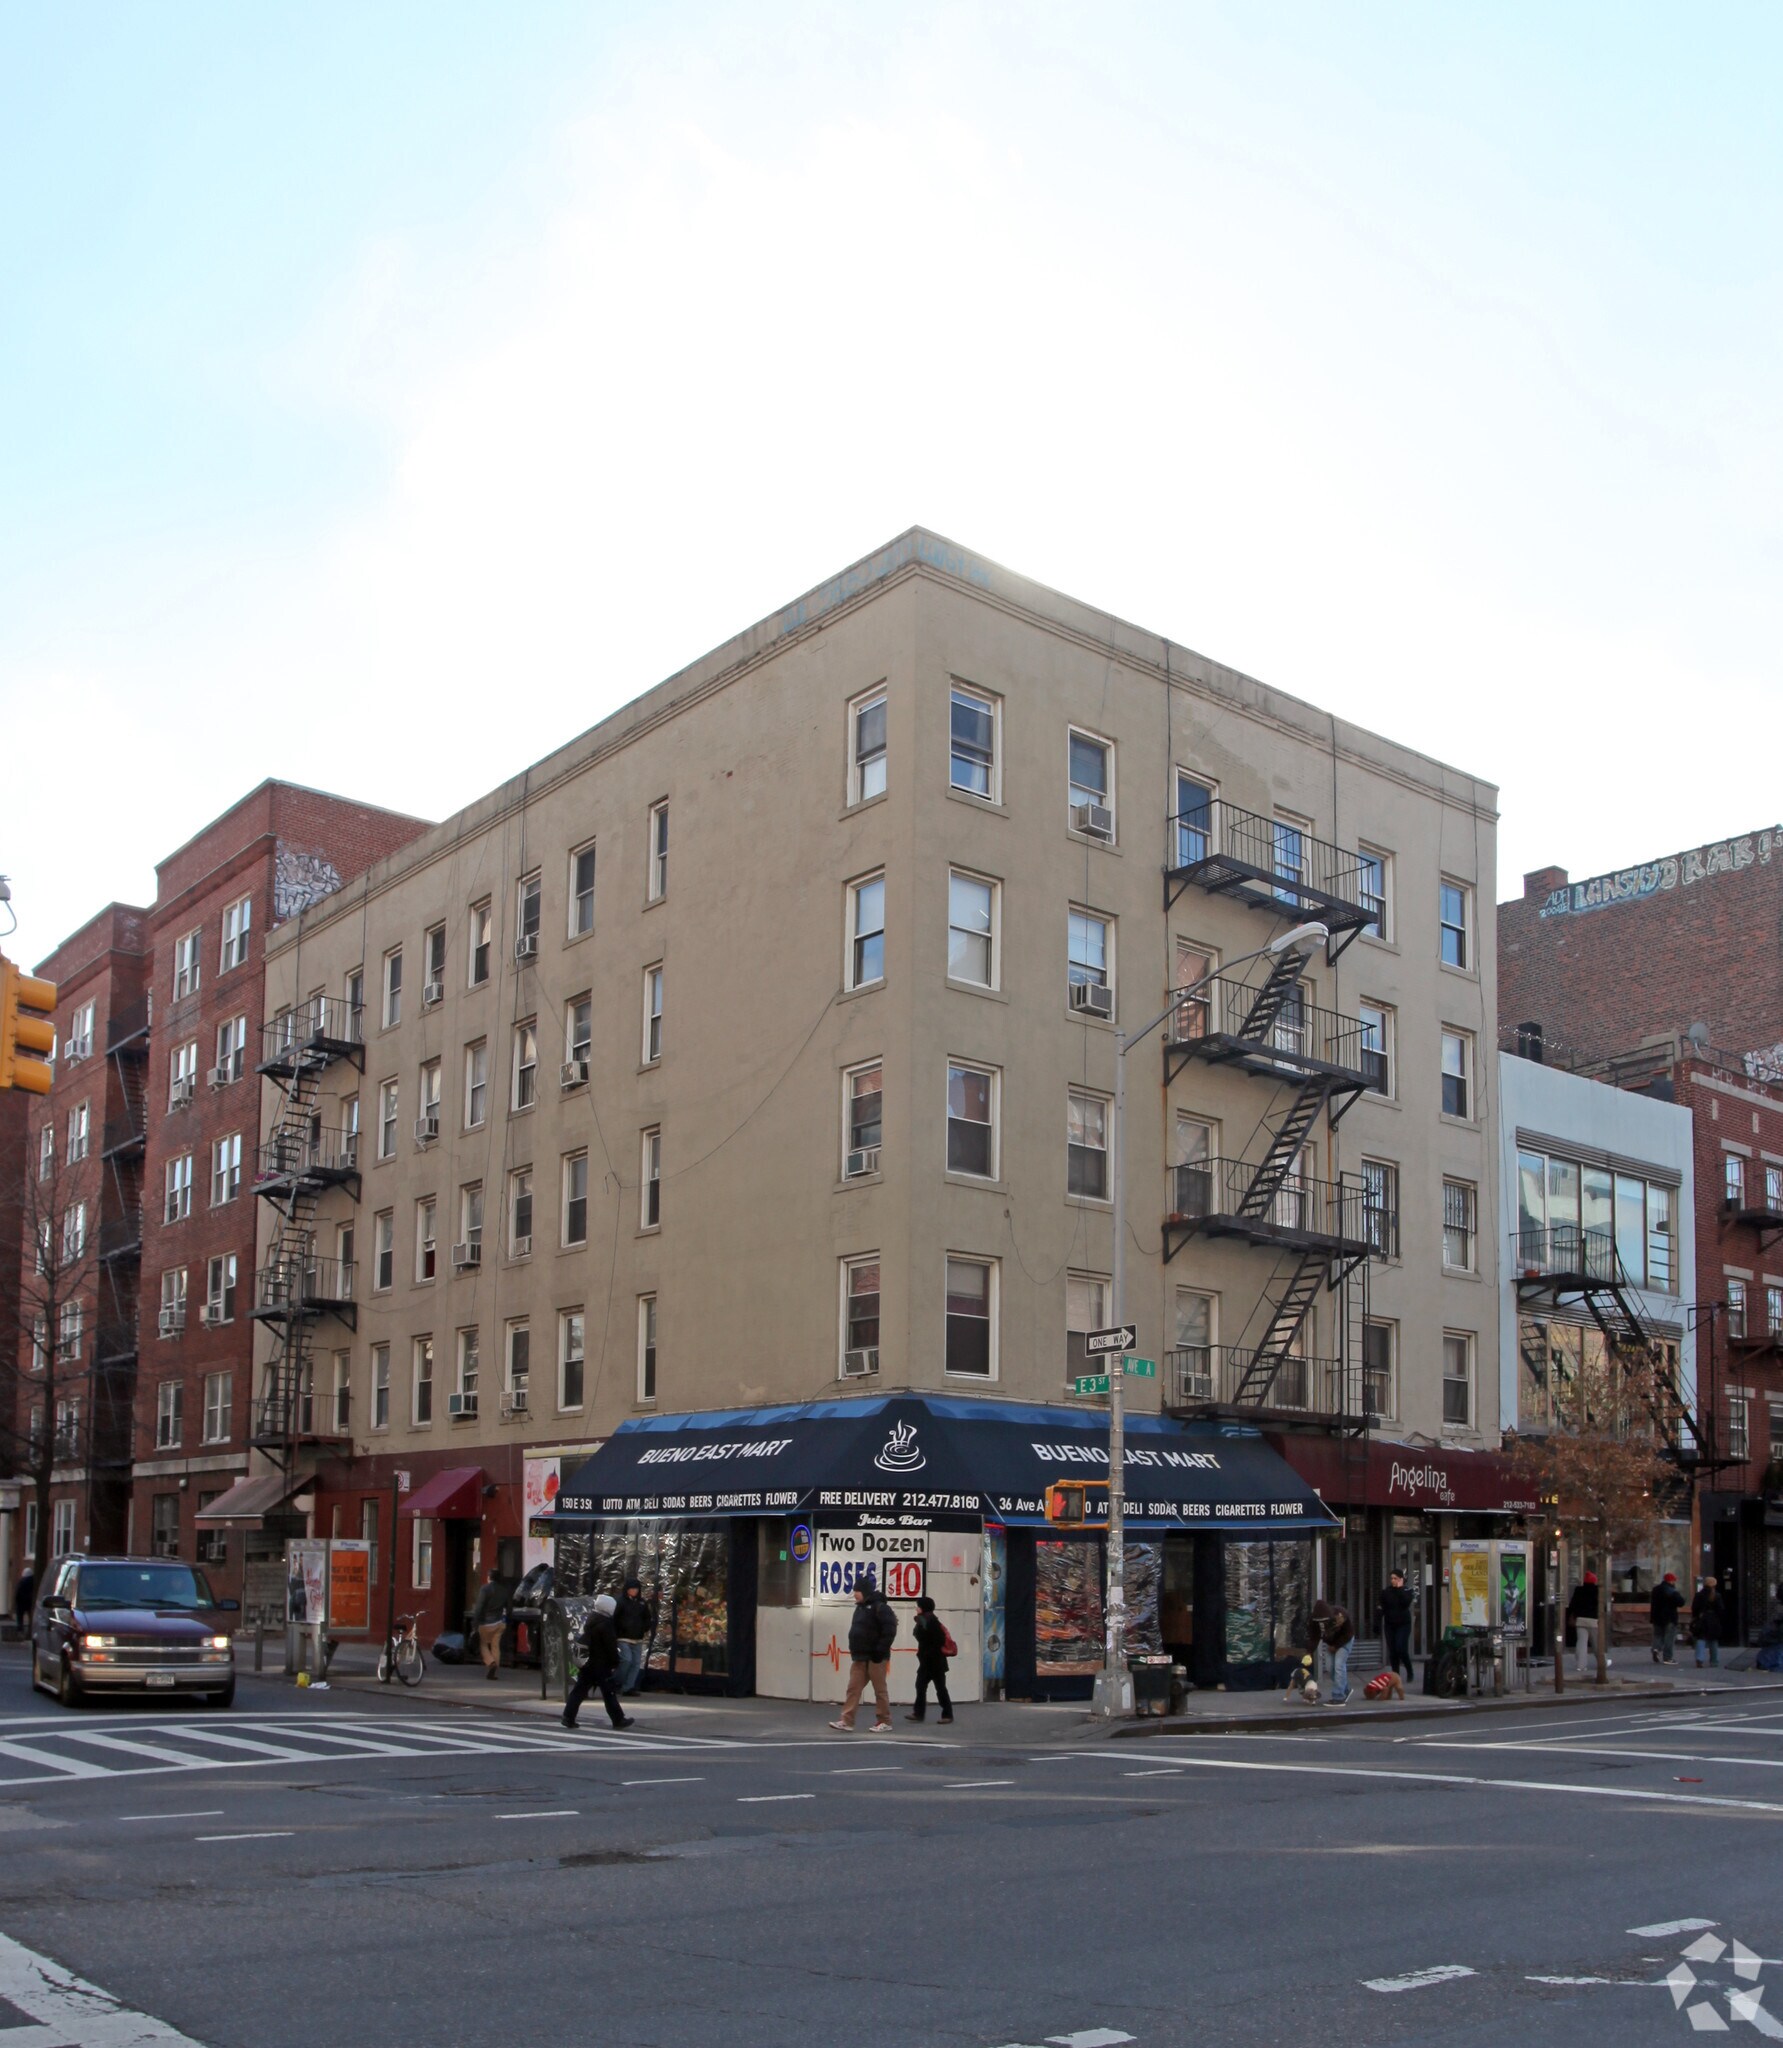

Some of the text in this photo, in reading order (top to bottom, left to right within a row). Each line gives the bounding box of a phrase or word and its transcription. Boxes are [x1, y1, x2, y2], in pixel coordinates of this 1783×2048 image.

[1092, 1333, 1128, 1348] ONE WAY
[1126, 1358, 1152, 1376] AVE A
[1080, 1376, 1106, 1393] E 3 ST
[637, 1439, 793, 1464] BUENO EAST MART
[1031, 1443, 1222, 1469] BUENO AST MART
[1389, 1461, 1447, 1497] Angelina
[562, 1497, 593, 1510] 150 E 3 St
[602, 1491, 798, 1510] LOTTO ATM DELI SODAS BEERS CIGARETTES FLOWER
[820, 1491, 980, 1509] FREE DELIVERY 212.477.8160
[999, 1497, 1045, 1512] 36 Ave A
[1439, 1488, 1456, 1506] cafe
[1097, 1501, 1109, 1514] AT
[1123, 1502, 1143, 1515] DELI
[1148, 1502, 1177, 1515] SODAS
[1182, 1503, 1210, 1516] BEERS
[1215, 1504, 1266, 1516] CIGARETTES
[1270, 1503, 1303, 1515] FLOWER
[857, 1513, 932, 1527] Juice Bar
[820, 1533, 855, 1552] Two
[862, 1533, 925, 1553] Dozen
[888, 1562, 922, 1597] $10
